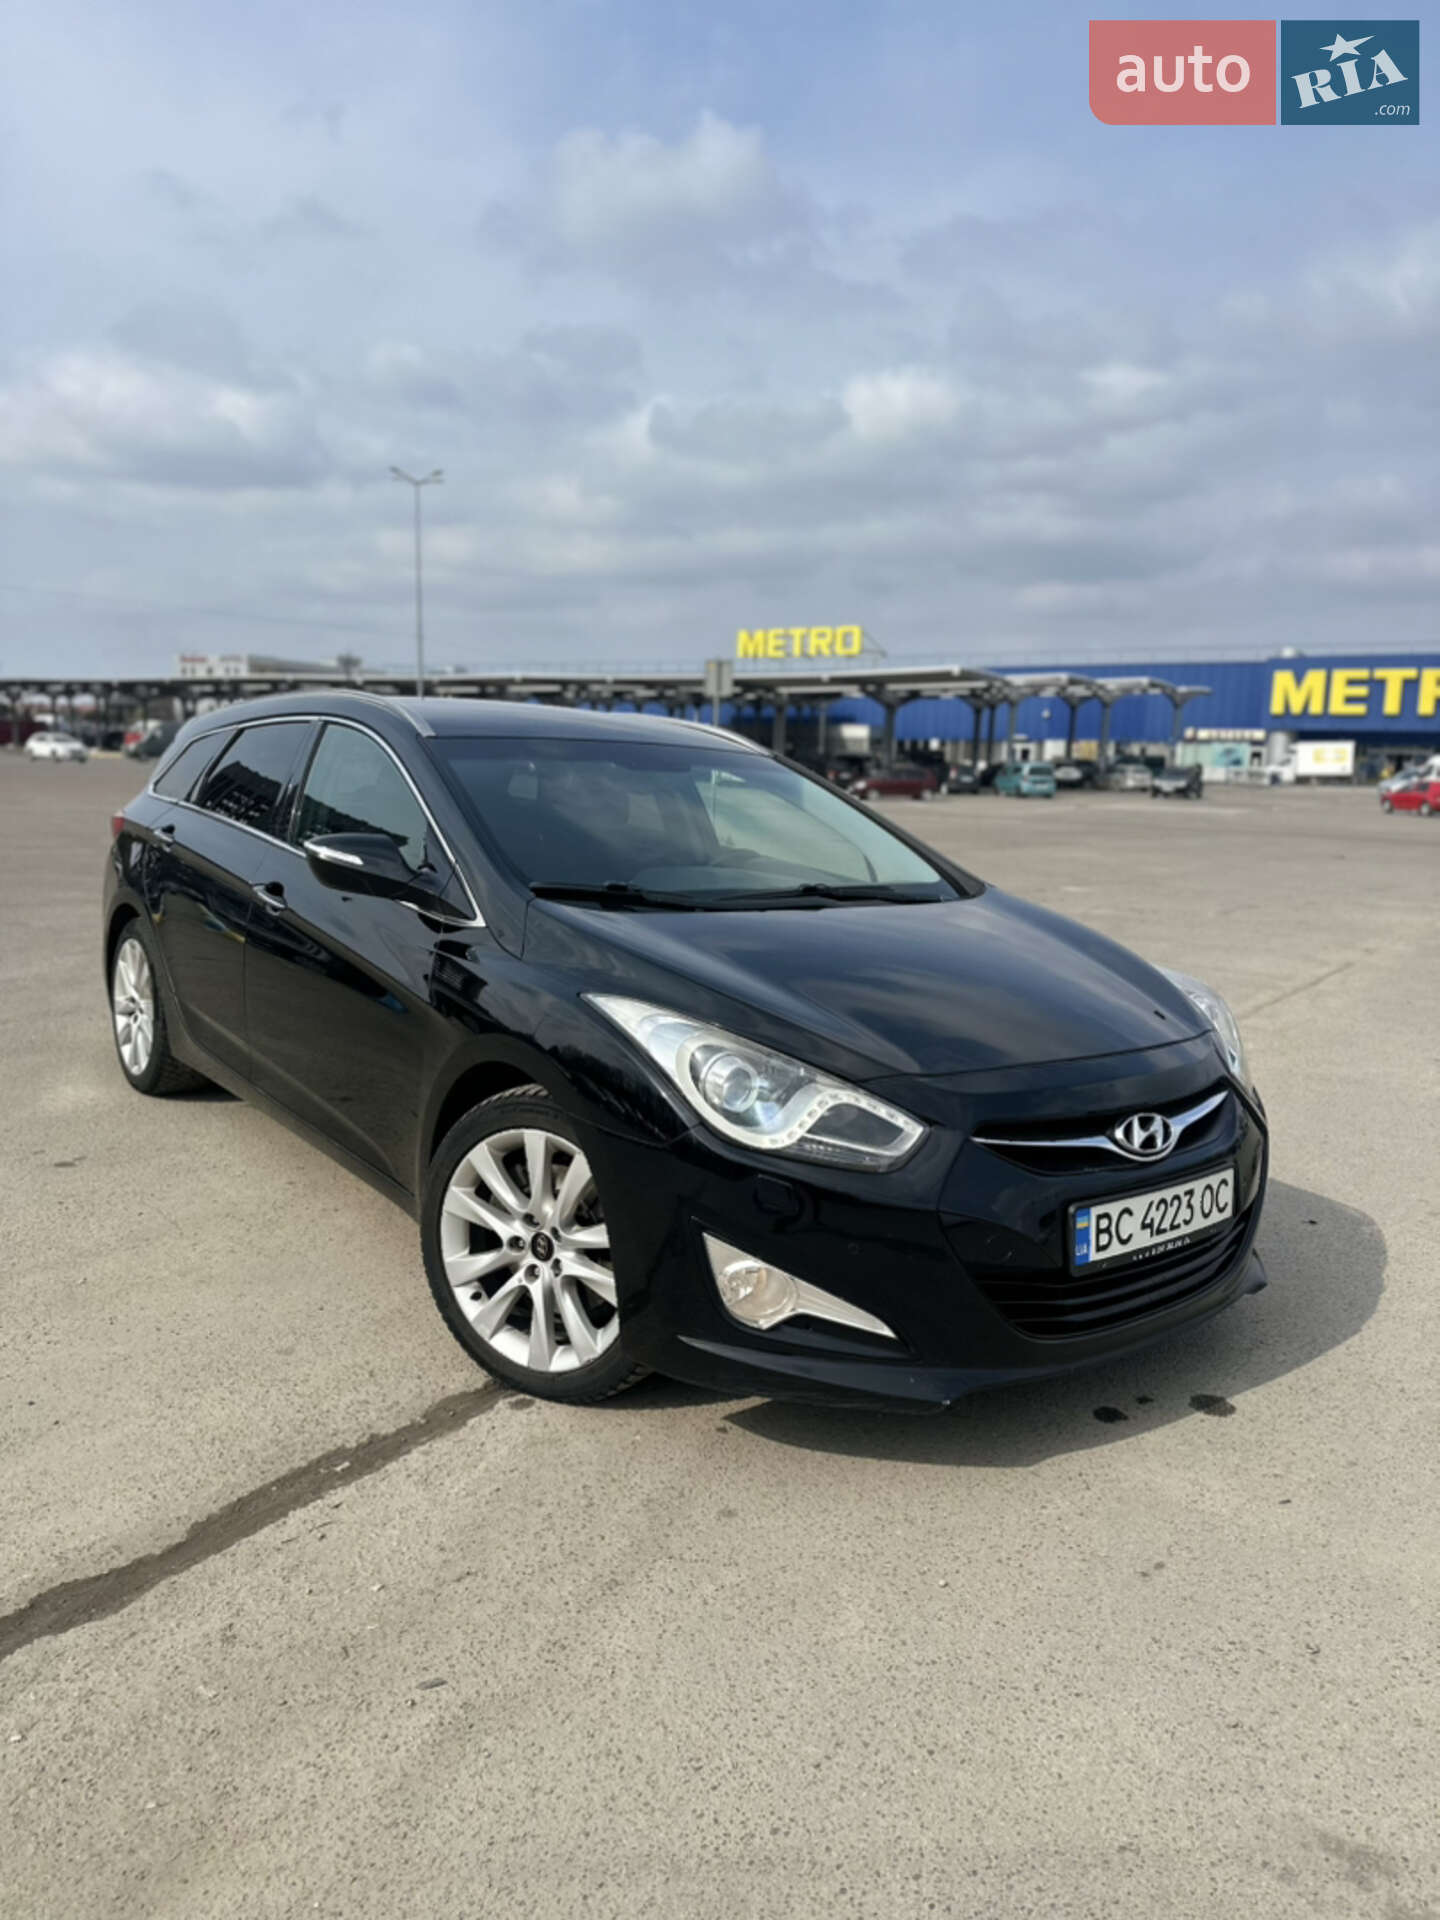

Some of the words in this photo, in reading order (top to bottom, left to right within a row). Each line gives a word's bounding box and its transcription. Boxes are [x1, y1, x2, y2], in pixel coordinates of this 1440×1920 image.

[736, 625, 864, 659] METRO
[1095, 1207, 1134, 1253] BC
[1140, 1188, 1195, 1238] 4223
[1200, 1178, 1229, 1219] OC
